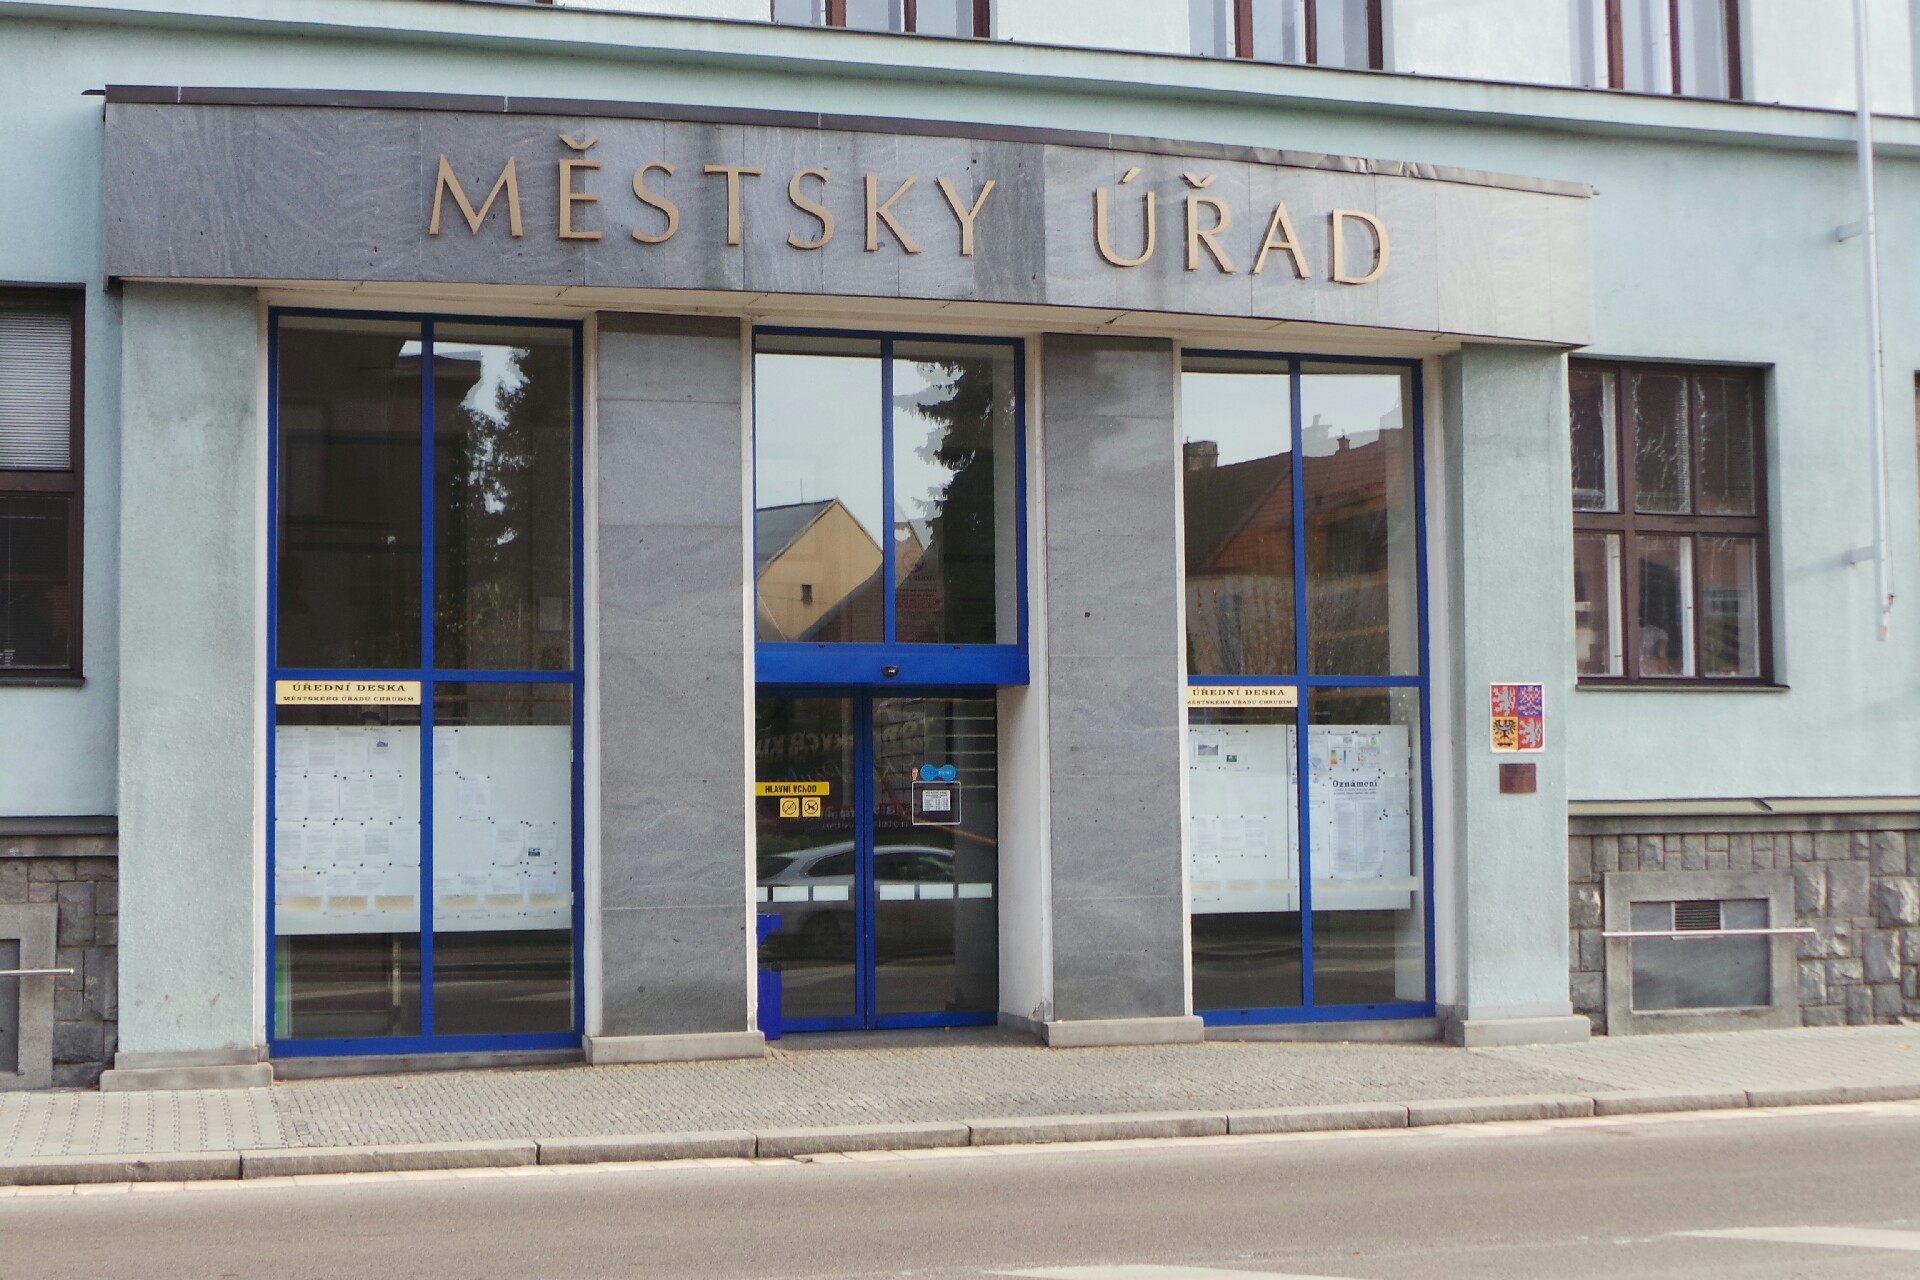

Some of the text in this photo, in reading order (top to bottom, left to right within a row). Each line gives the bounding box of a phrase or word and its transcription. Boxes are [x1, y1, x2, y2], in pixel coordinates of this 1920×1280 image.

[1092, 167, 1391, 285] ÚŘAD
[292, 681, 406, 692] ÚŘEDNÍ DESKA
[1192, 687, 1241, 696] ÚŘEDNÍ
[1332, 779, 1378, 788] Oznámení
[765, 784, 791, 793] HLAVNÍ
